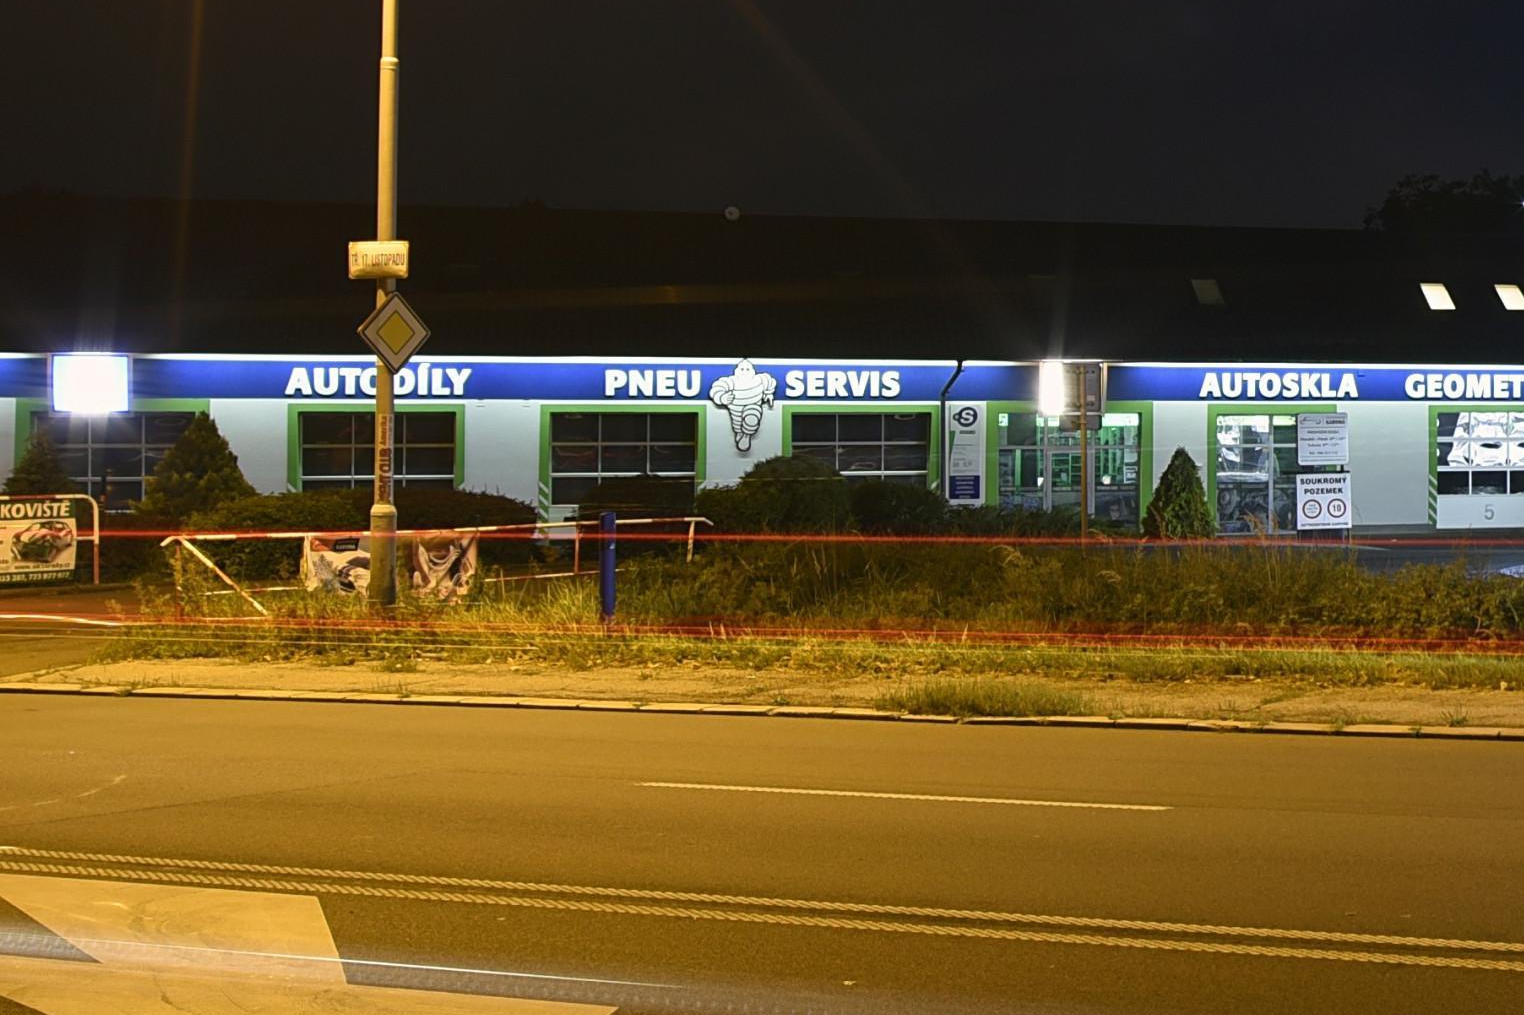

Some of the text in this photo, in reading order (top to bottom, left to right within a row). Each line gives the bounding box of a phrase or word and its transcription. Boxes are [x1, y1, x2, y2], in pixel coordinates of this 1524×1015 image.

[284, 362, 472, 396] AUTODÍLY
[604, 369, 901, 398] PNEU SERVIS
[1199, 371, 1359, 399] AUTOSKLA
[1304, 487, 1344, 495] POZEMEK
[1484, 503, 1495, 521] 5
